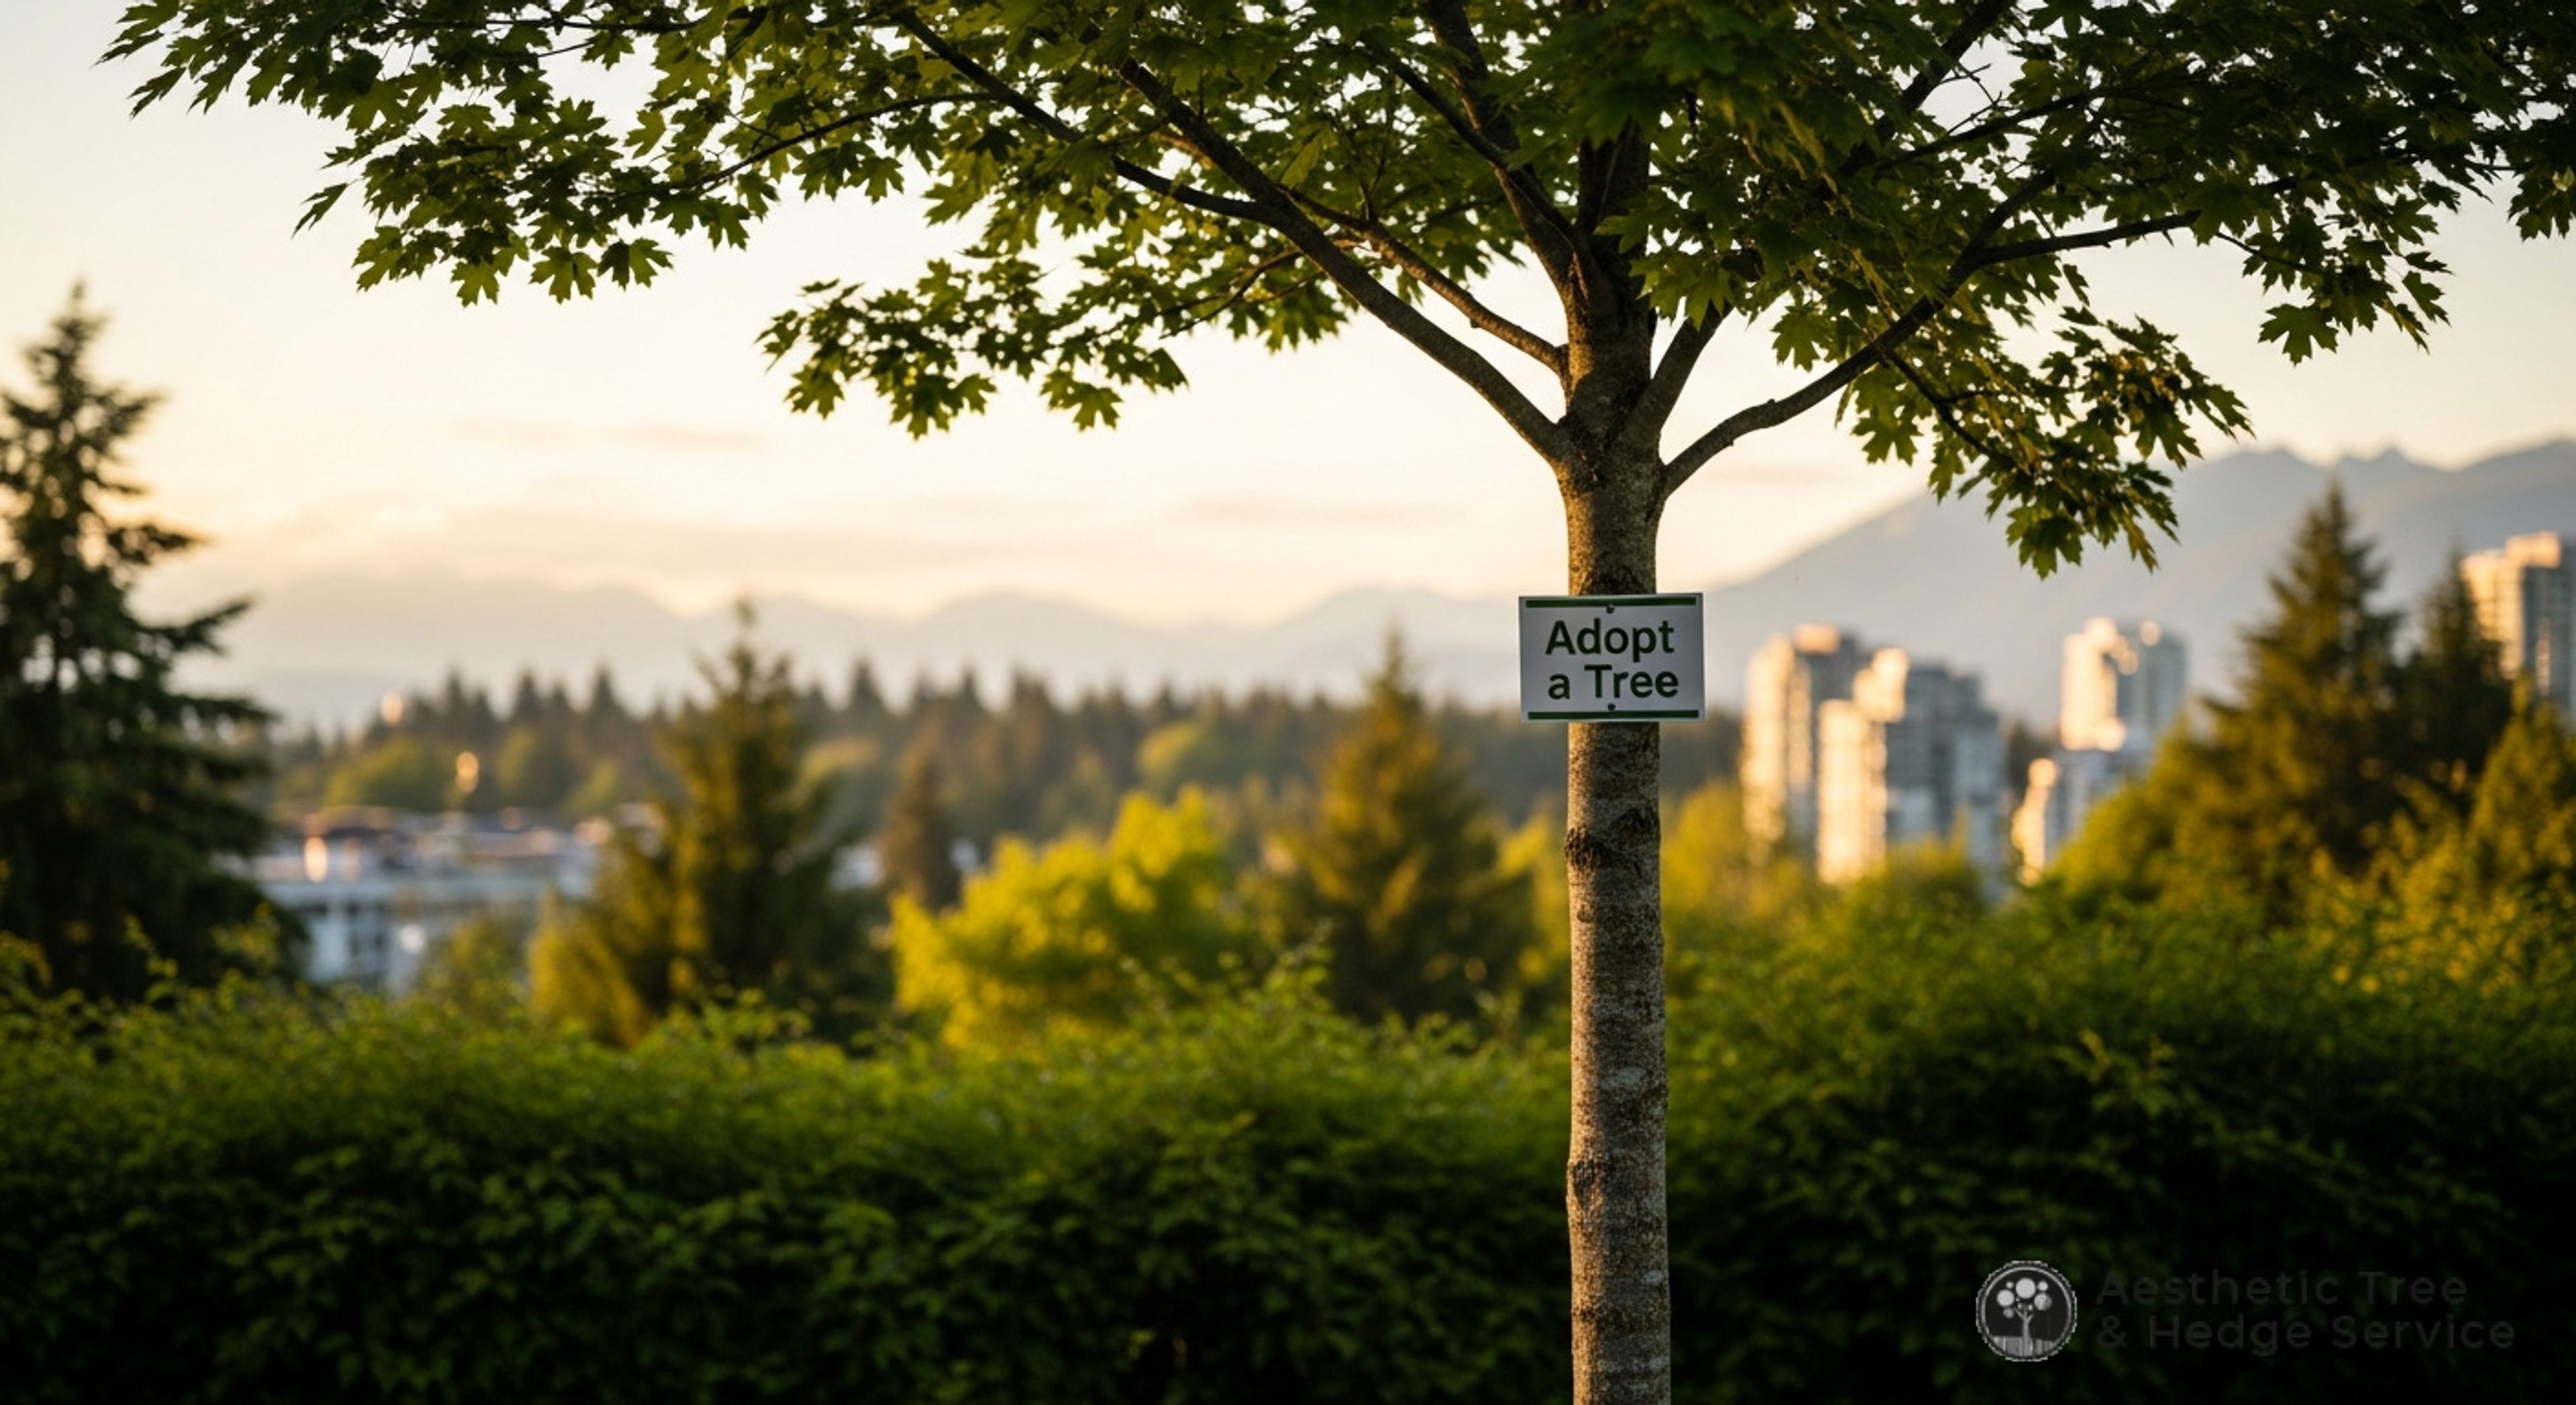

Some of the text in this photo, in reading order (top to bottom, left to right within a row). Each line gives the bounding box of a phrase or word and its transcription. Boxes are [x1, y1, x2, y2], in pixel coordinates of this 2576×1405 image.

[1545, 618, 1674, 663] Adopt
[1548, 664, 1678, 699] a Tree
